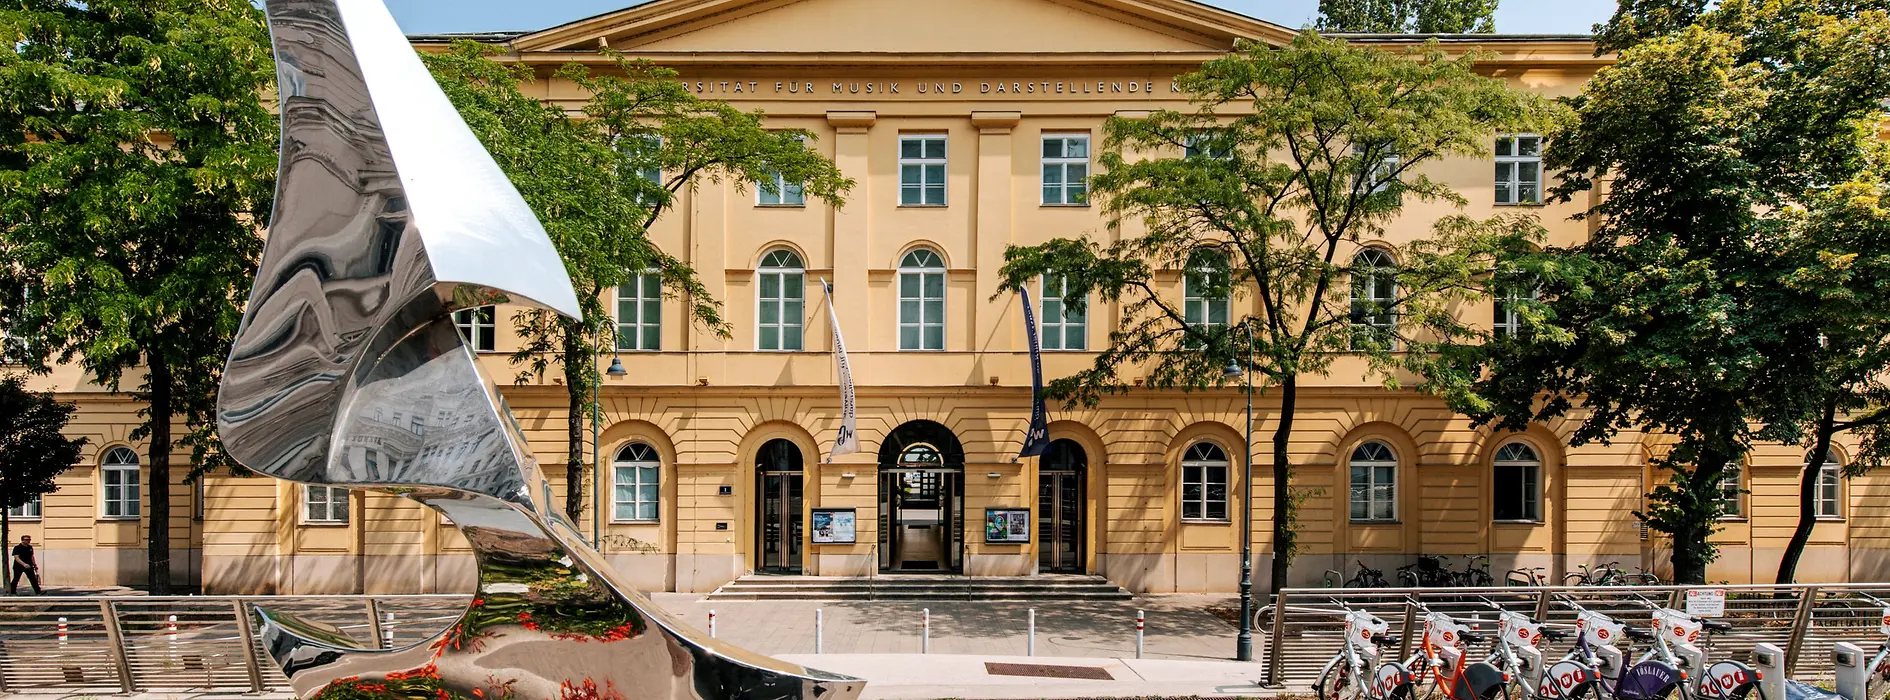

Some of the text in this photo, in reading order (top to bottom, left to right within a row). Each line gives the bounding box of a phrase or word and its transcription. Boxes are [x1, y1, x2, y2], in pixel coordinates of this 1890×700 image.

[775, 81, 814, 93] FÜR
[832, 82, 899, 93] MUSIK
[917, 82, 963, 93] UND
[980, 81, 1153, 93] DARSTELLENDE
